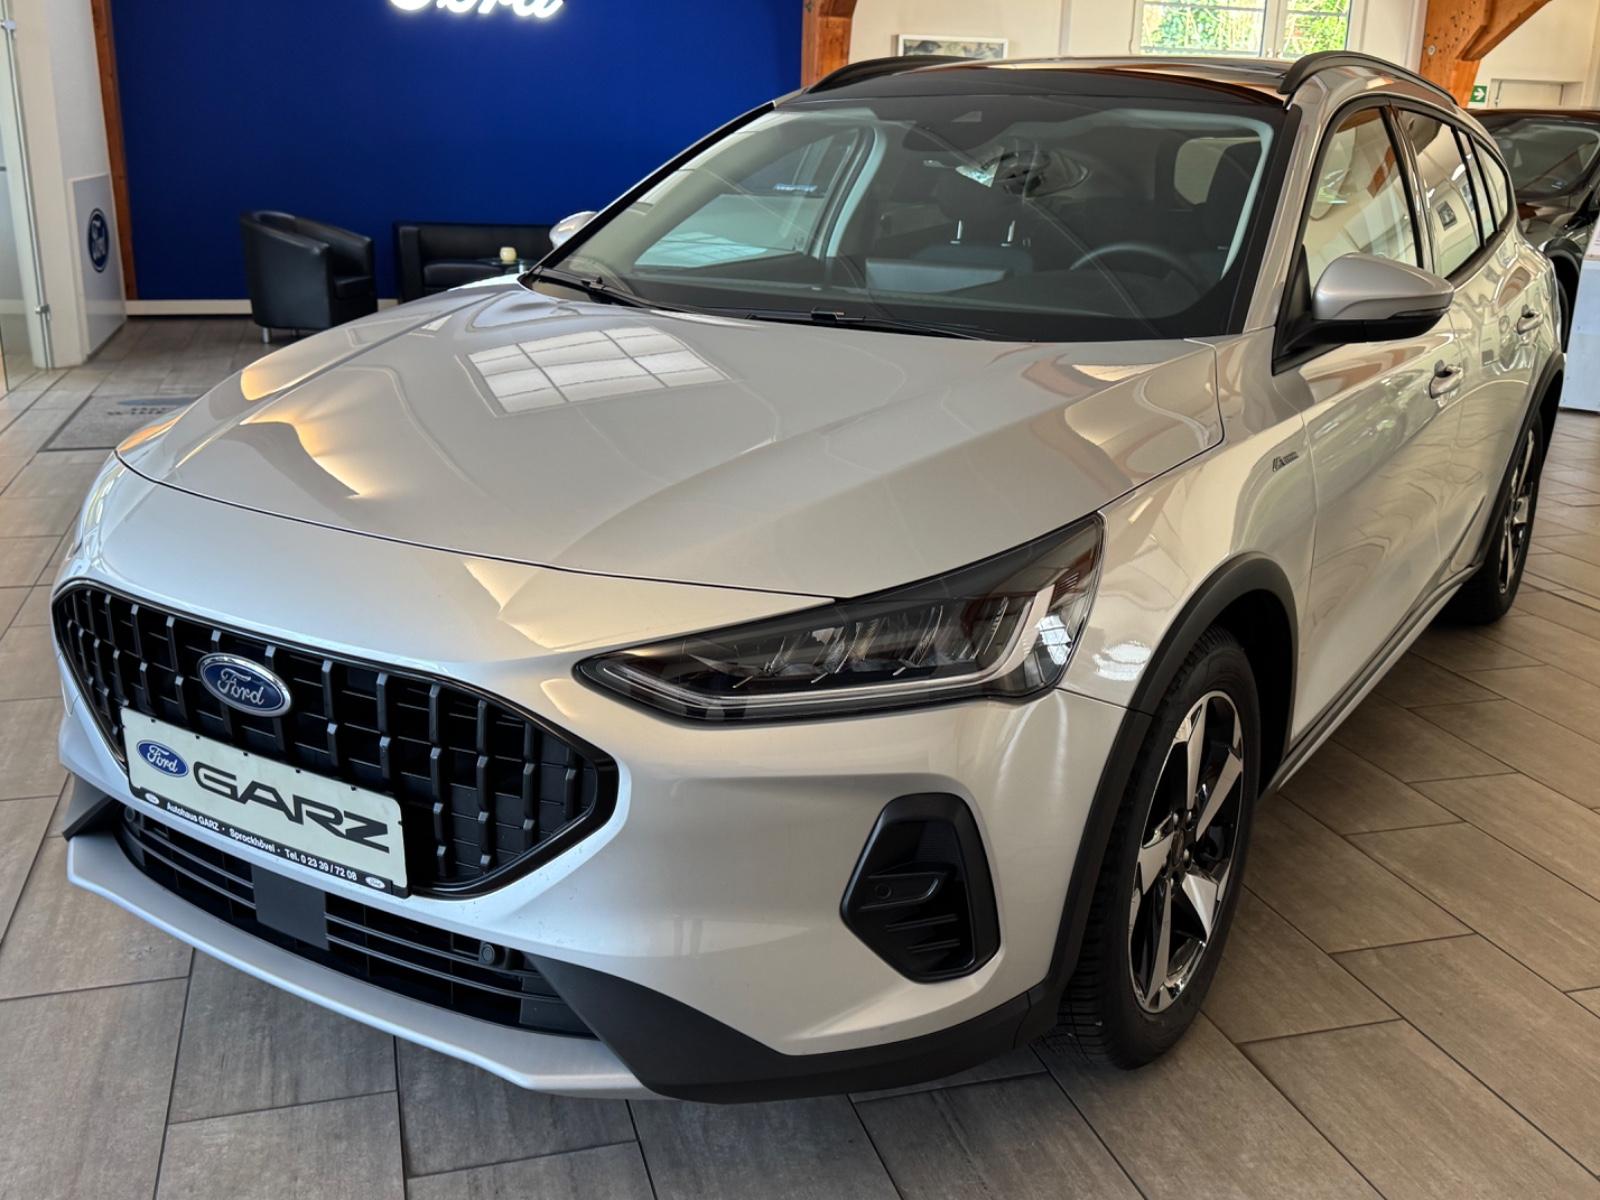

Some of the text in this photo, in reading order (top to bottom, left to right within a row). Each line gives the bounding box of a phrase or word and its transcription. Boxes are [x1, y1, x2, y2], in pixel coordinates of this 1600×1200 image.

[217, 667, 265, 705] Ford
[147, 744, 178, 773] Ford
[193, 761, 390, 854] GARZ
[167, 802, 198, 822] Autohaus
[198, 816, 219, 831] GARZ
[284, 848, 300, 862] Tel.
[307, 856, 318, 867] 23
[319, 859, 329, 872] 39
[335, 866, 346, 877] 72
